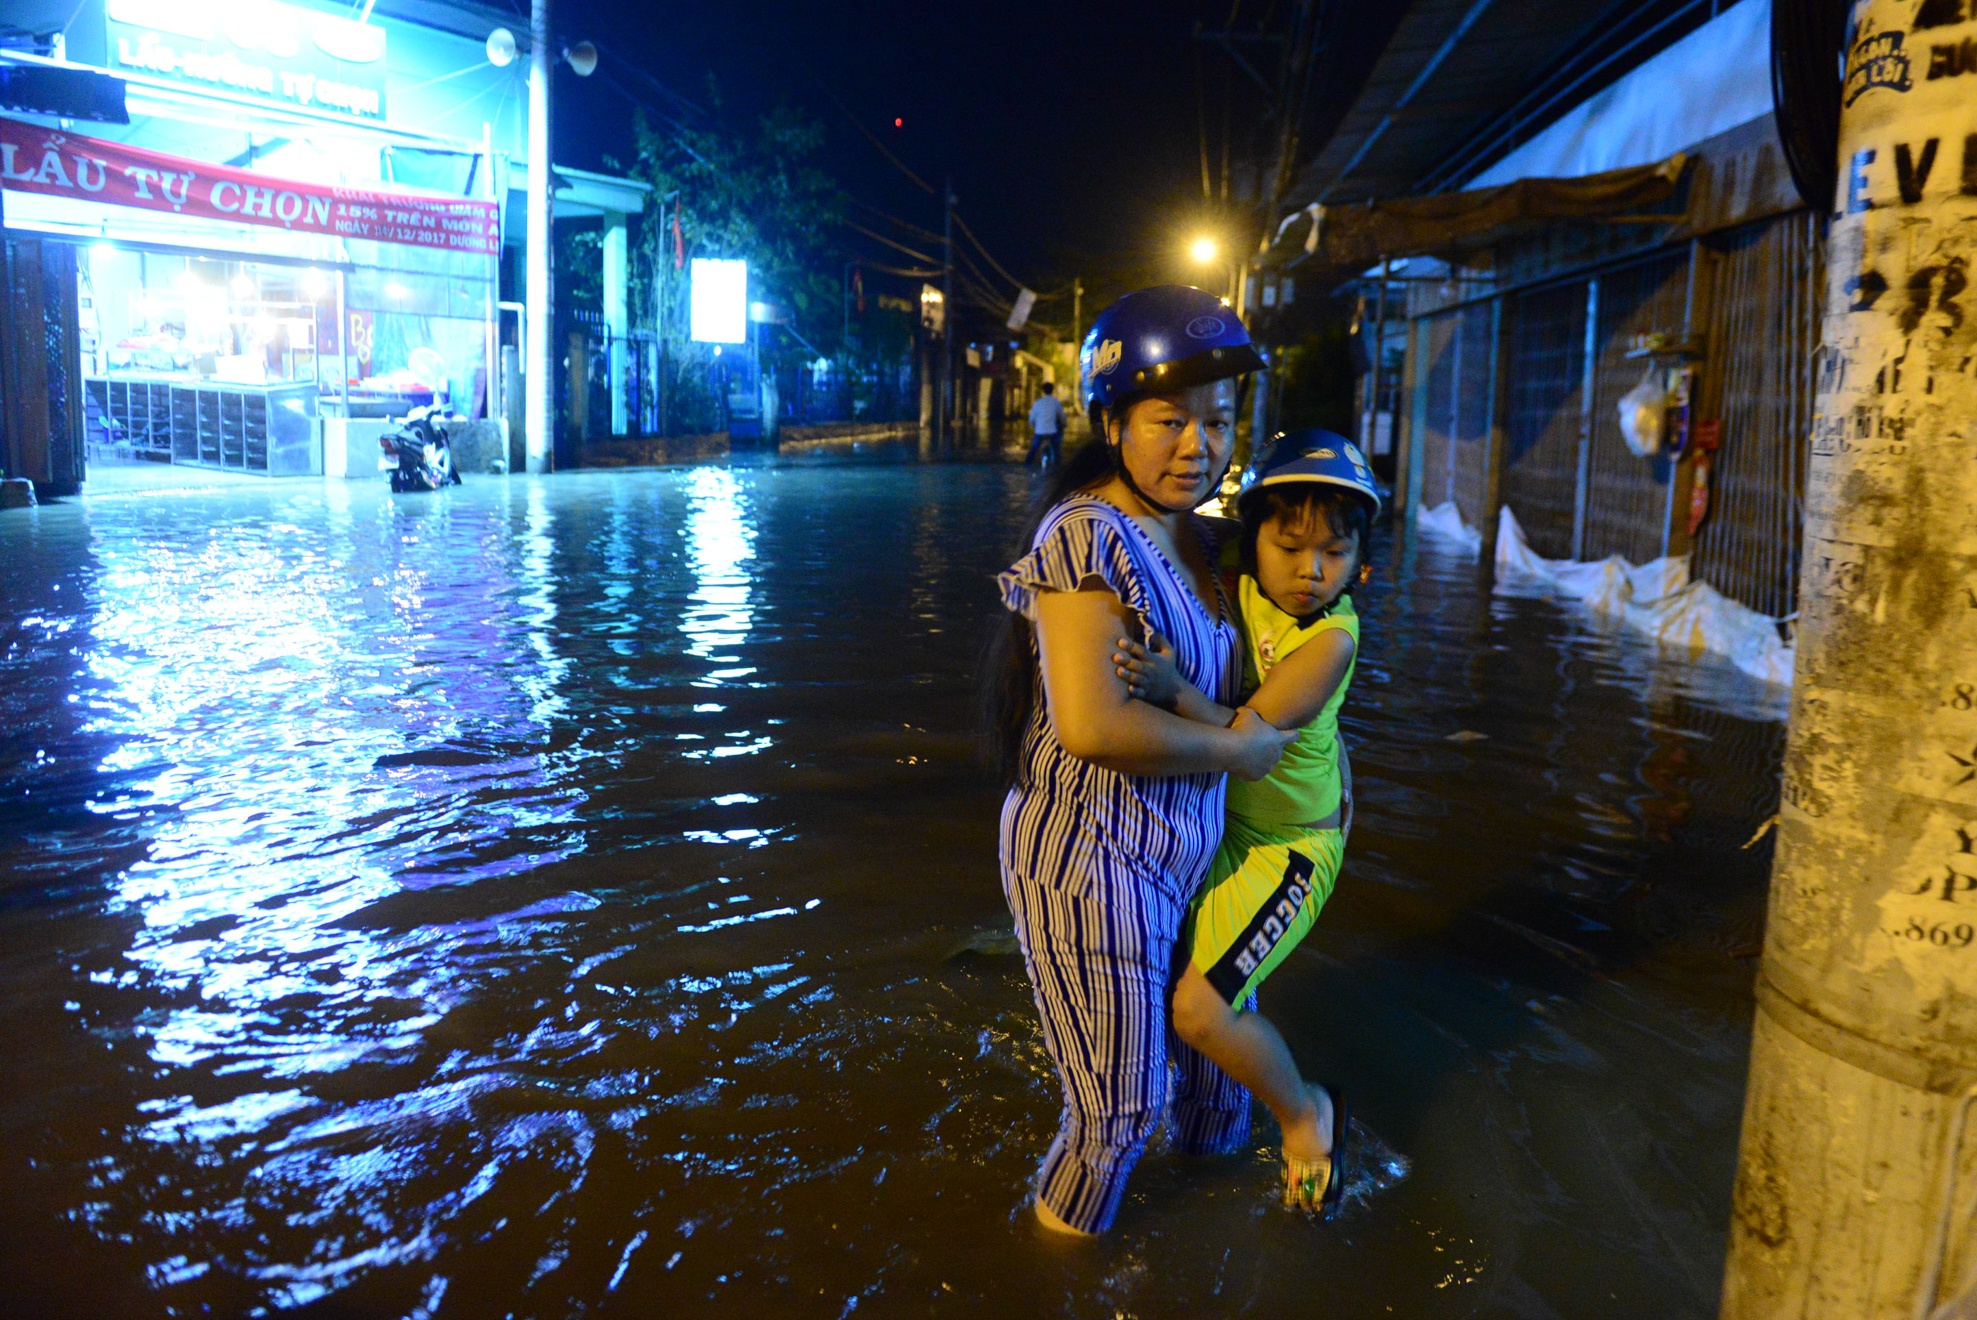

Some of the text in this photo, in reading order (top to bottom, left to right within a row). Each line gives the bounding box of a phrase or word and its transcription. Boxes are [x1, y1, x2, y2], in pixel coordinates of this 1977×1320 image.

[1, 134, 333, 229] LẨU TỰ CHỌN
[335, 219, 370, 236] NGÀY
[336, 203, 378, 220] 15%
[384, 209, 436, 228] TRÊN
[1234, 872, 1312, 977] SOCCER
